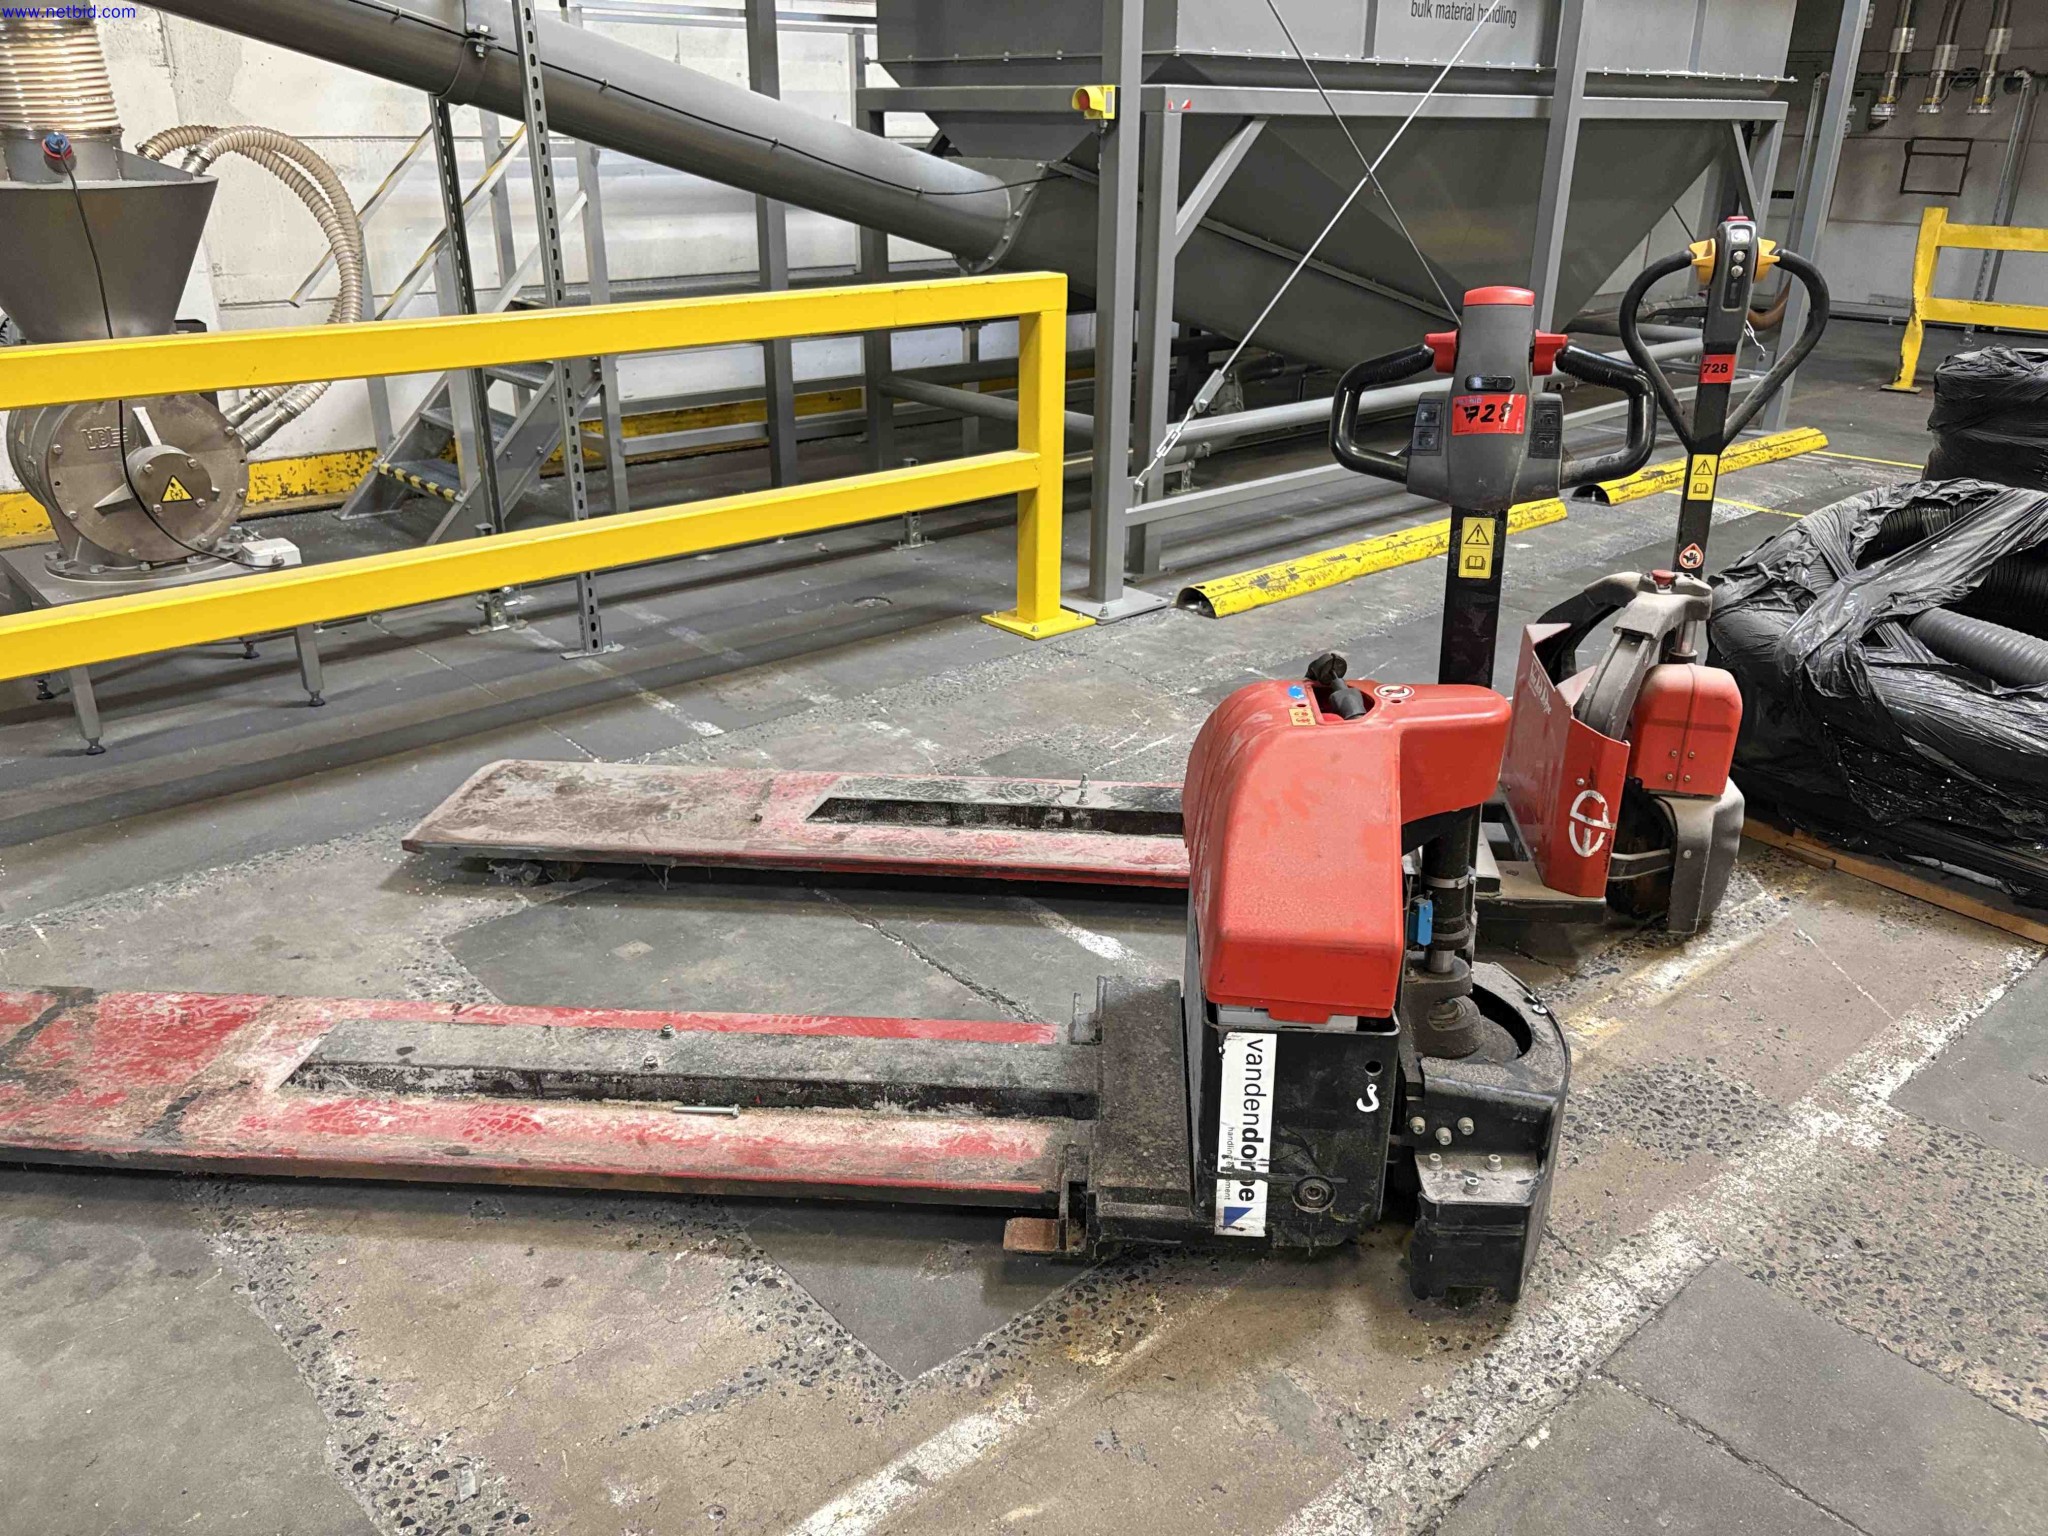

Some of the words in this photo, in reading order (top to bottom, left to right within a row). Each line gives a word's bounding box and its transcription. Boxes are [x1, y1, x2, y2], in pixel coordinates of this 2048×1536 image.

[1411, 0, 1432, 18] bulk
[1435, 2, 1476, 21] material
[1477, 5, 1517, 28] handling
[1702, 363, 1729, 374] 728
[1463, 402, 1513, 424] 728
